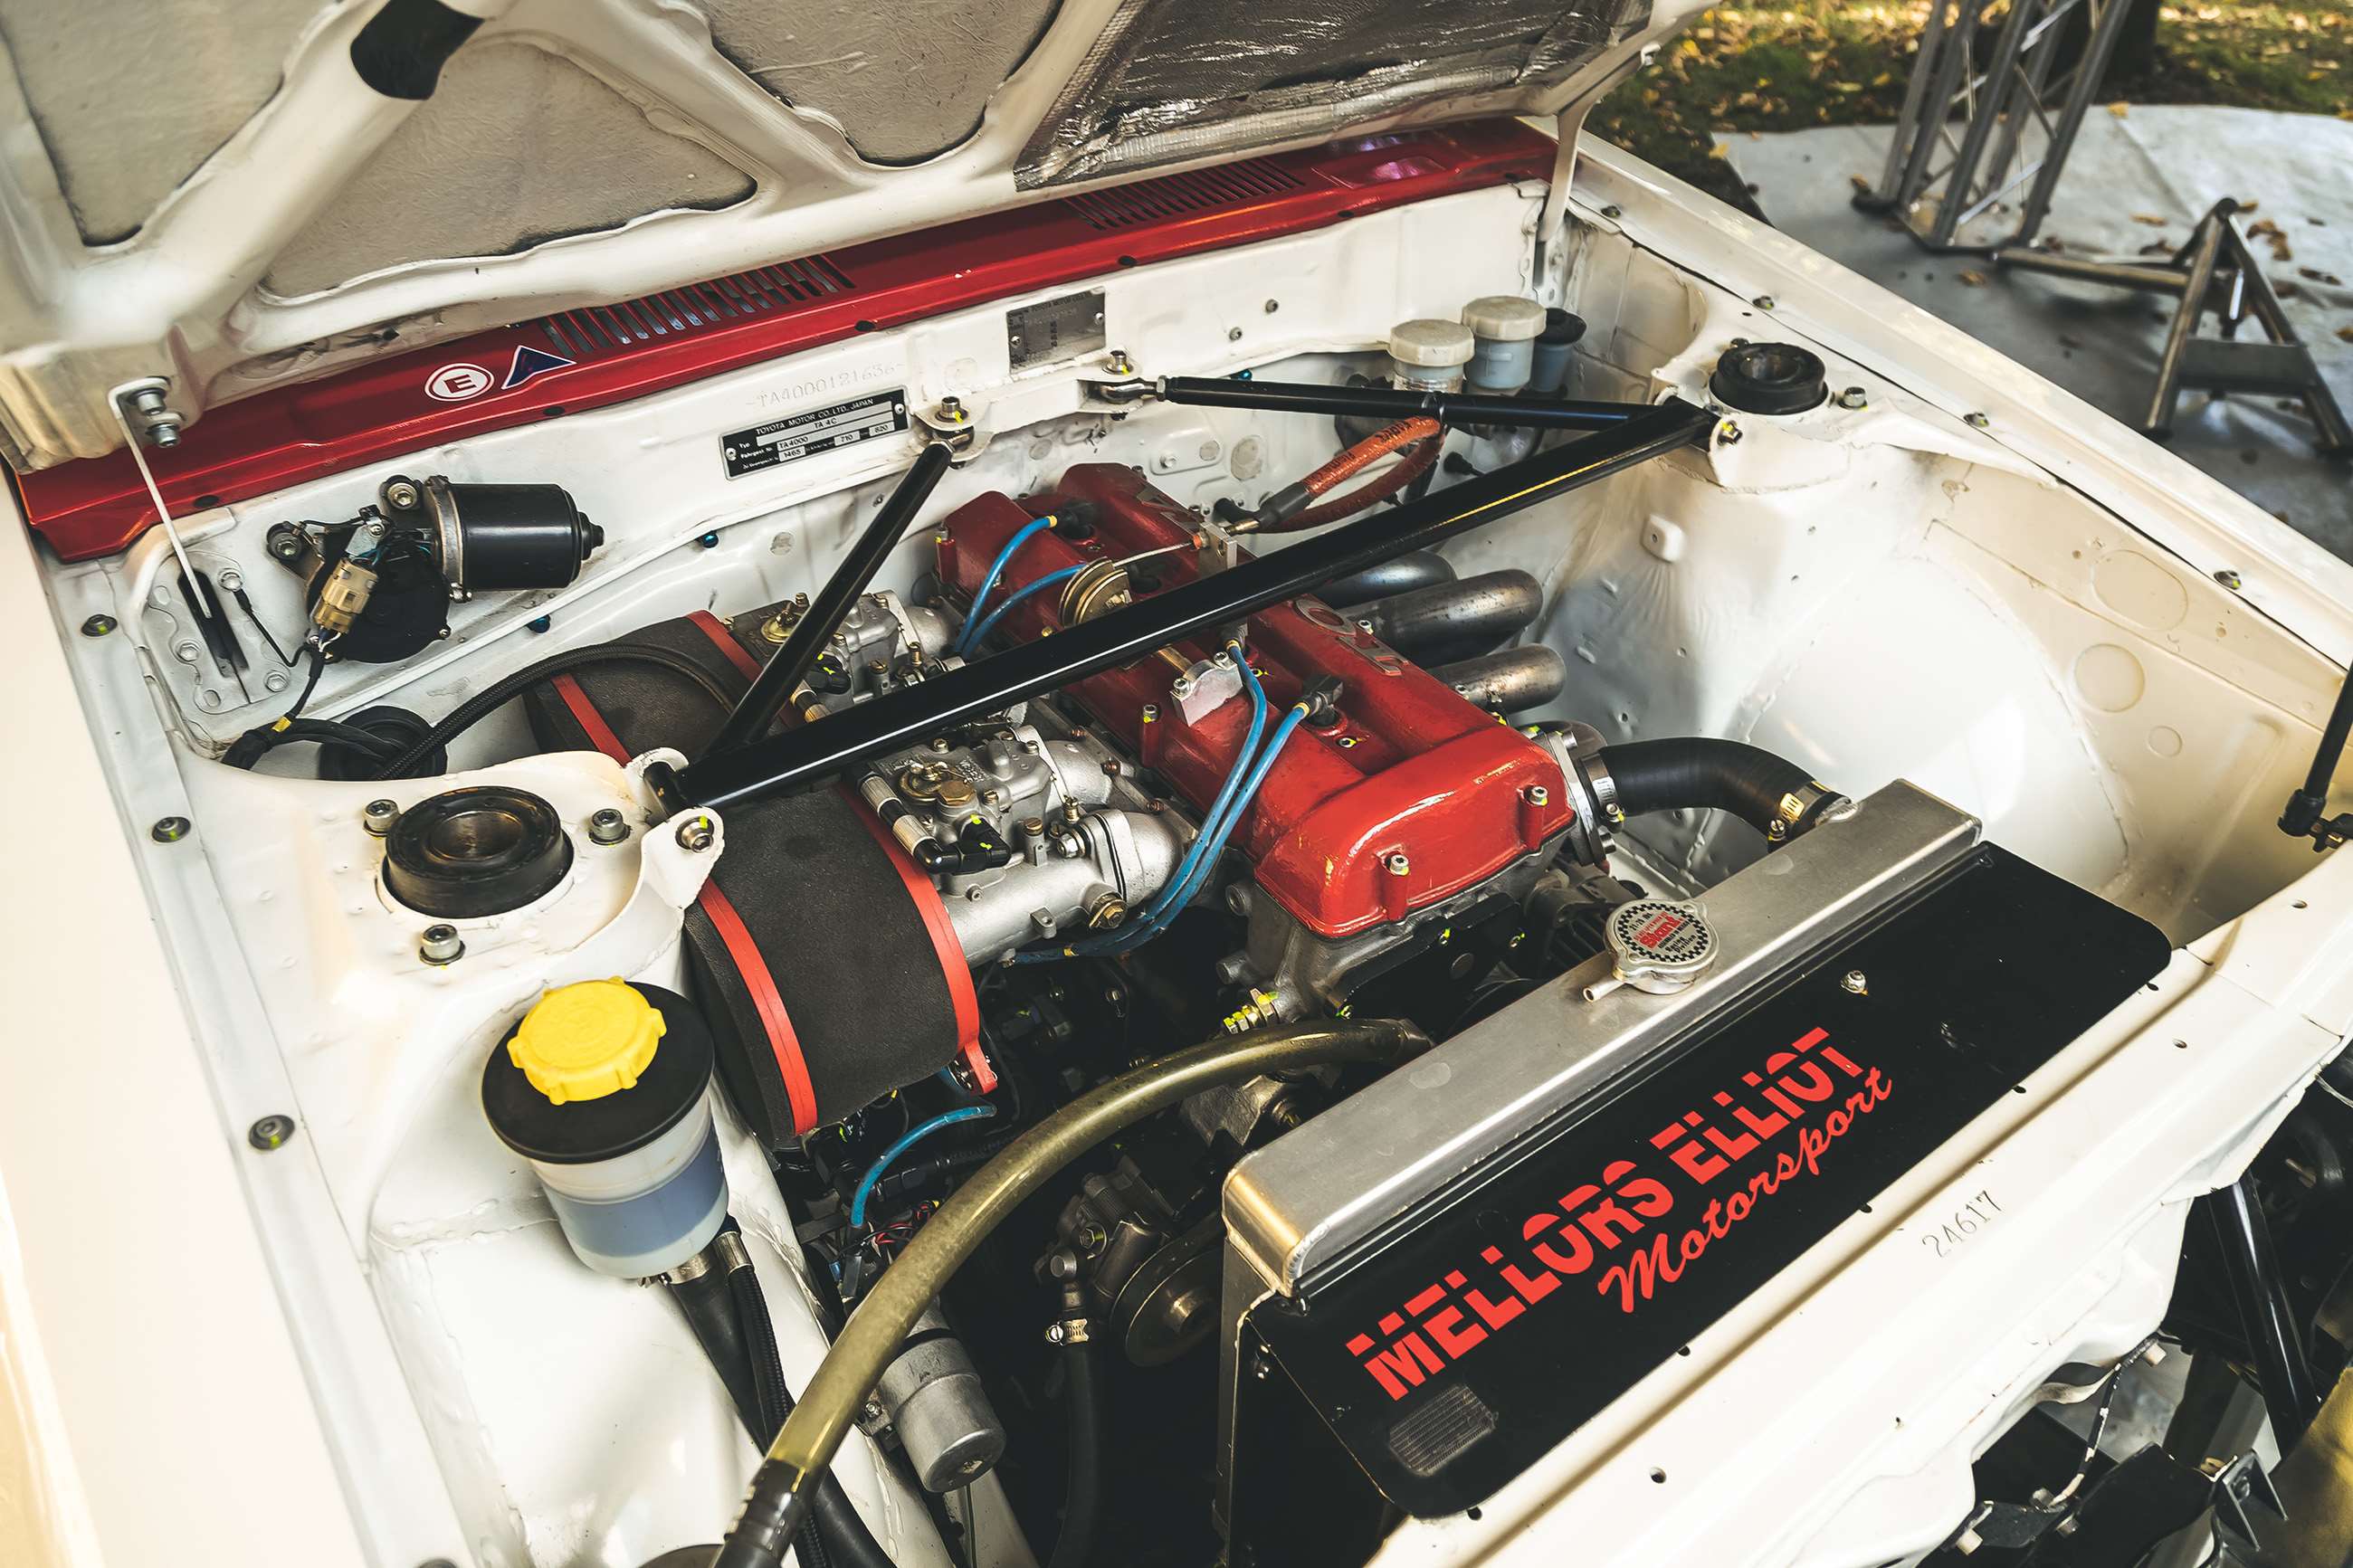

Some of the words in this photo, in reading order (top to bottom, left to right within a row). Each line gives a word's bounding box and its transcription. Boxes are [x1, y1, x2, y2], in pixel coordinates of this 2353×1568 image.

[443, 374, 477, 394] E
[756, 422, 786, 435] TOYOTA
[787, 413, 815, 427] MOTOR
[851, 398, 874, 410] JAPAN
[779, 436, 808, 449] TA4000
[1346, 1160, 1673, 1401] MELLORS
[1650, 1027, 1864, 1184] ELLIOT
[1597, 1067, 1892, 1313] Motorsport
[1921, 1190, 2002, 1258] 24617
